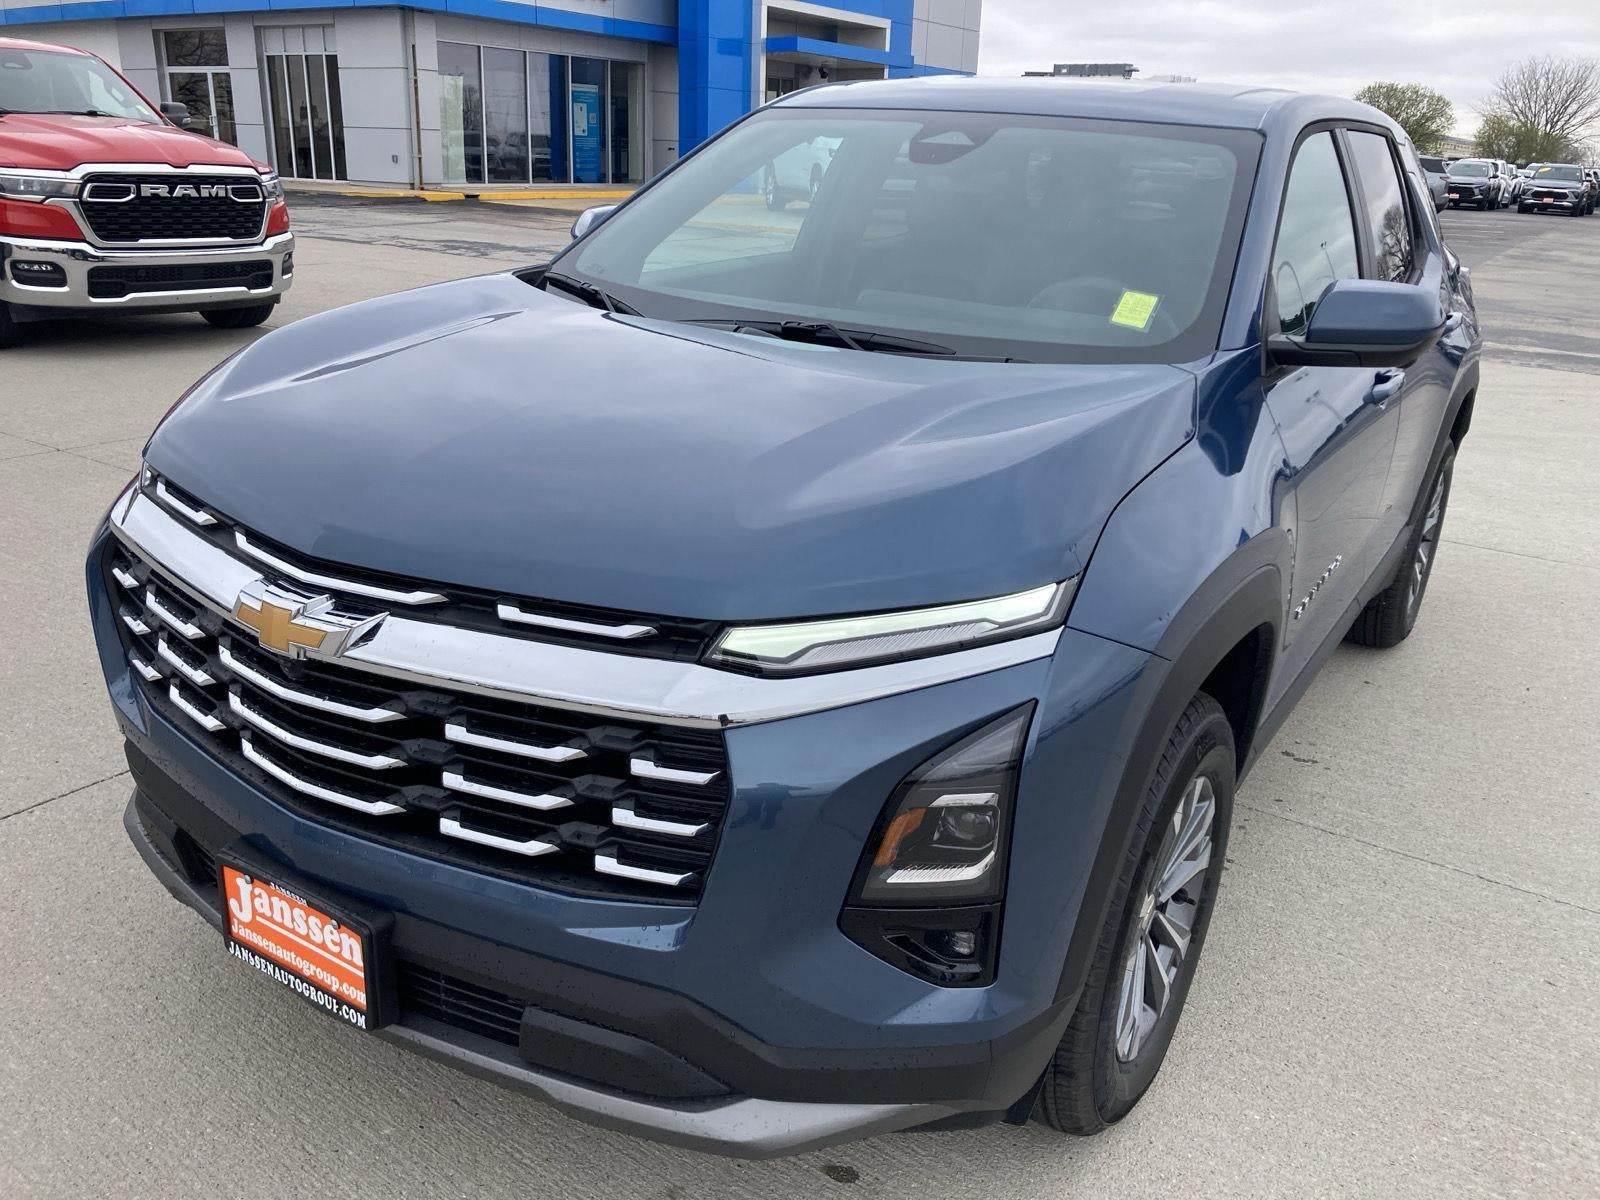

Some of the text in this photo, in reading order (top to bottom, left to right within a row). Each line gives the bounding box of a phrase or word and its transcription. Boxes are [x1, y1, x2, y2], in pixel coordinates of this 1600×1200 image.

[140, 184, 226, 198] RAM
[229, 876, 364, 967] Janssen
[231, 918, 367, 1006] Janssenautogroup.com
